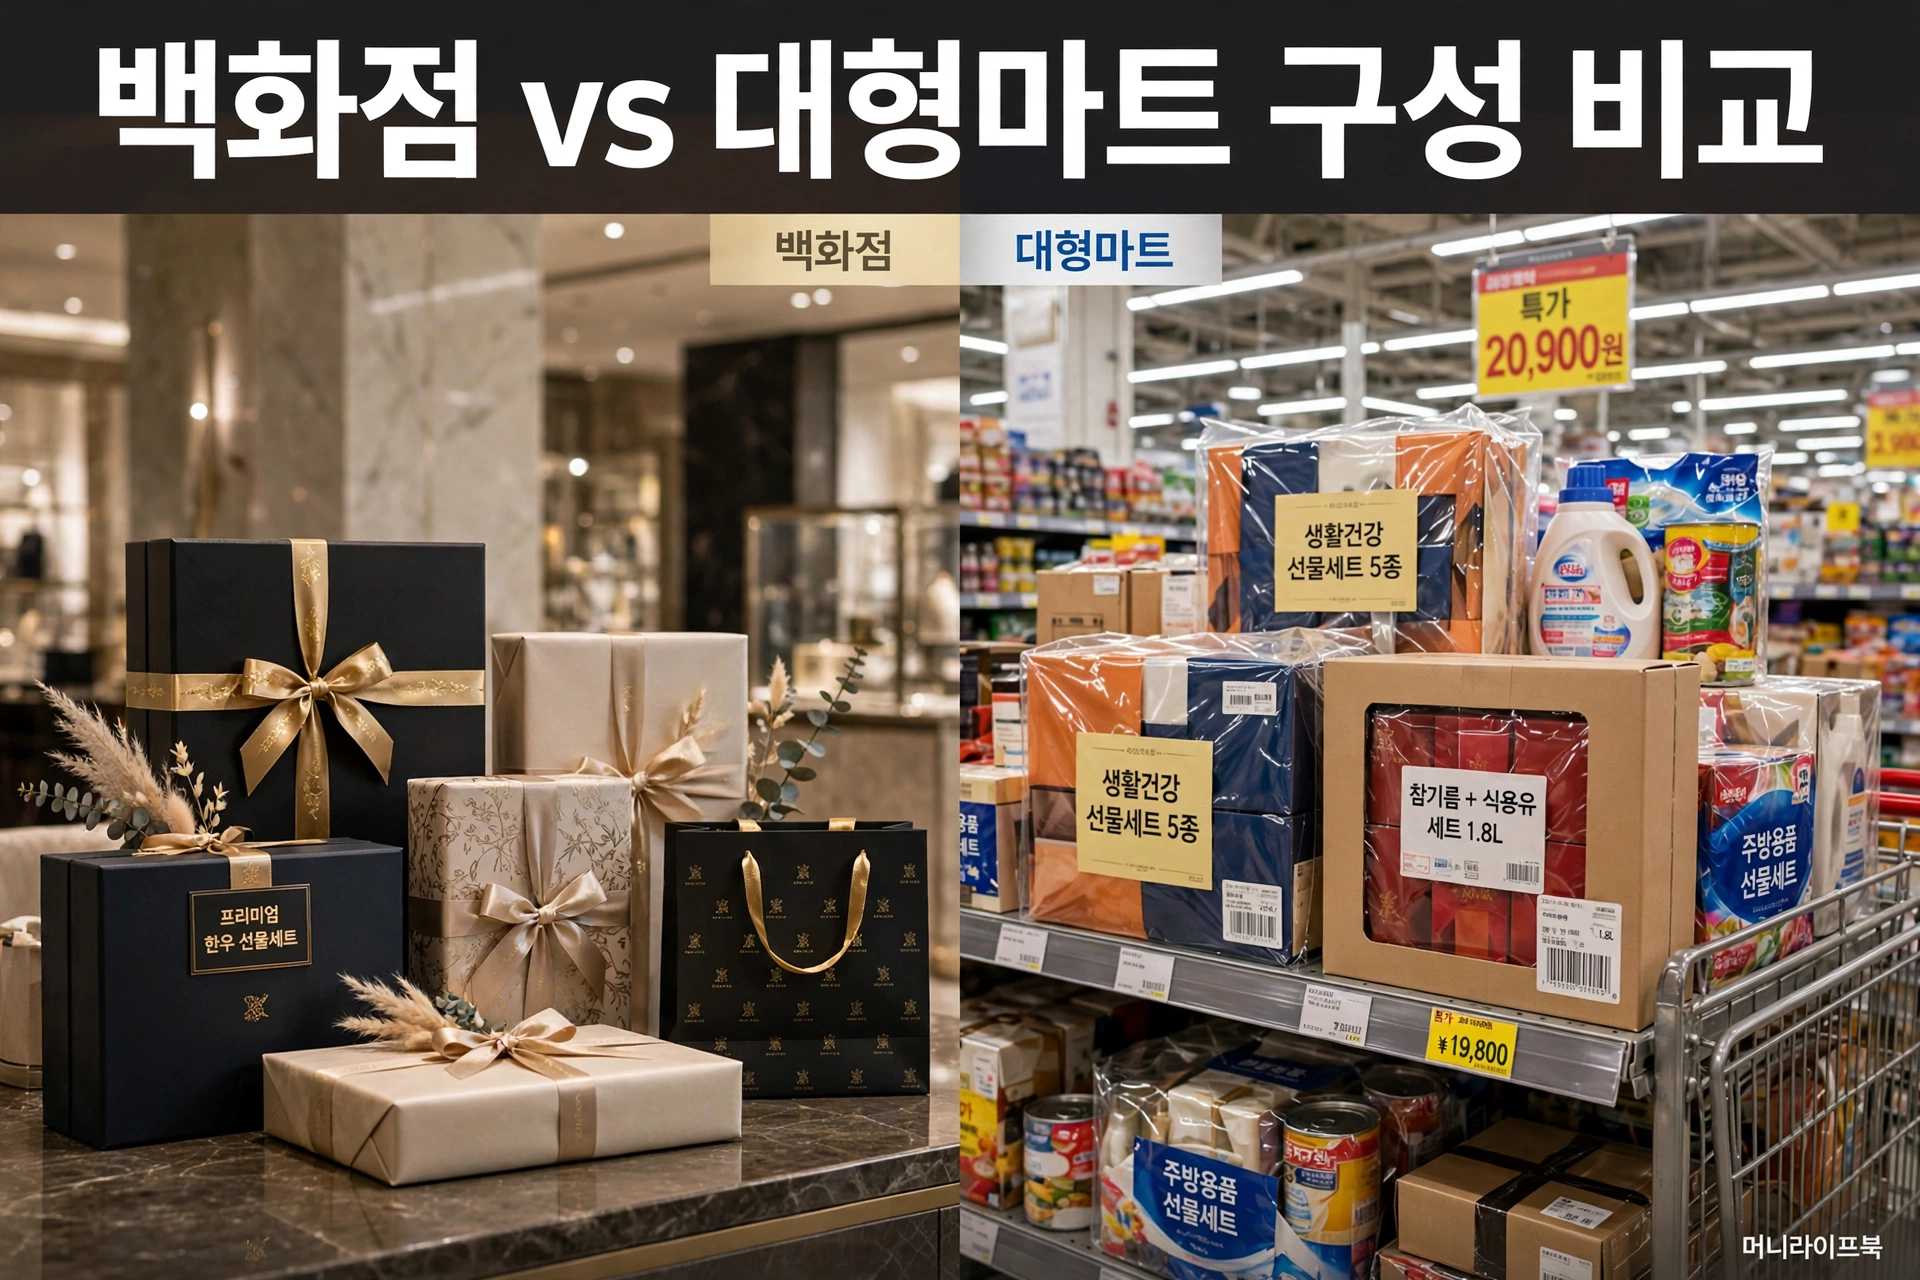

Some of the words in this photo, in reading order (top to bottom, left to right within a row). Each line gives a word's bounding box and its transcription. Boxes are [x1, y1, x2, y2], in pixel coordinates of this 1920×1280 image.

[1520, 287, 1571, 322] 특가
[1485, 323, 1624, 381] 20,900원
[1304, 520, 1384, 549] 생활건강
[1287, 554, 1364, 581] 선물세트
[1369, 553, 1403, 580] 5종
[1102, 768, 1181, 804] 생활건강
[1409, 782, 1461, 810] 참기름
[1465, 792, 1477, 807] +
[1482, 789, 1537, 817] 식용유
[1086, 804, 1162, 839] 선물세트
[1167, 813, 1200, 844] 5종
[1427, 816, 1462, 840] 세트
[1467, 820, 1504, 845] 1.8L
[1741, 824, 1798, 864] 주방용품
[1740, 858, 1798, 901] 선물세트
[220, 904, 279, 926] 프리미엄
[204, 934, 236, 954] 한우
[238, 929, 299, 951] 선물세트
[1162, 1158, 1239, 1206] 주방용품
[1162, 1191, 1239, 1238] 선물세트
